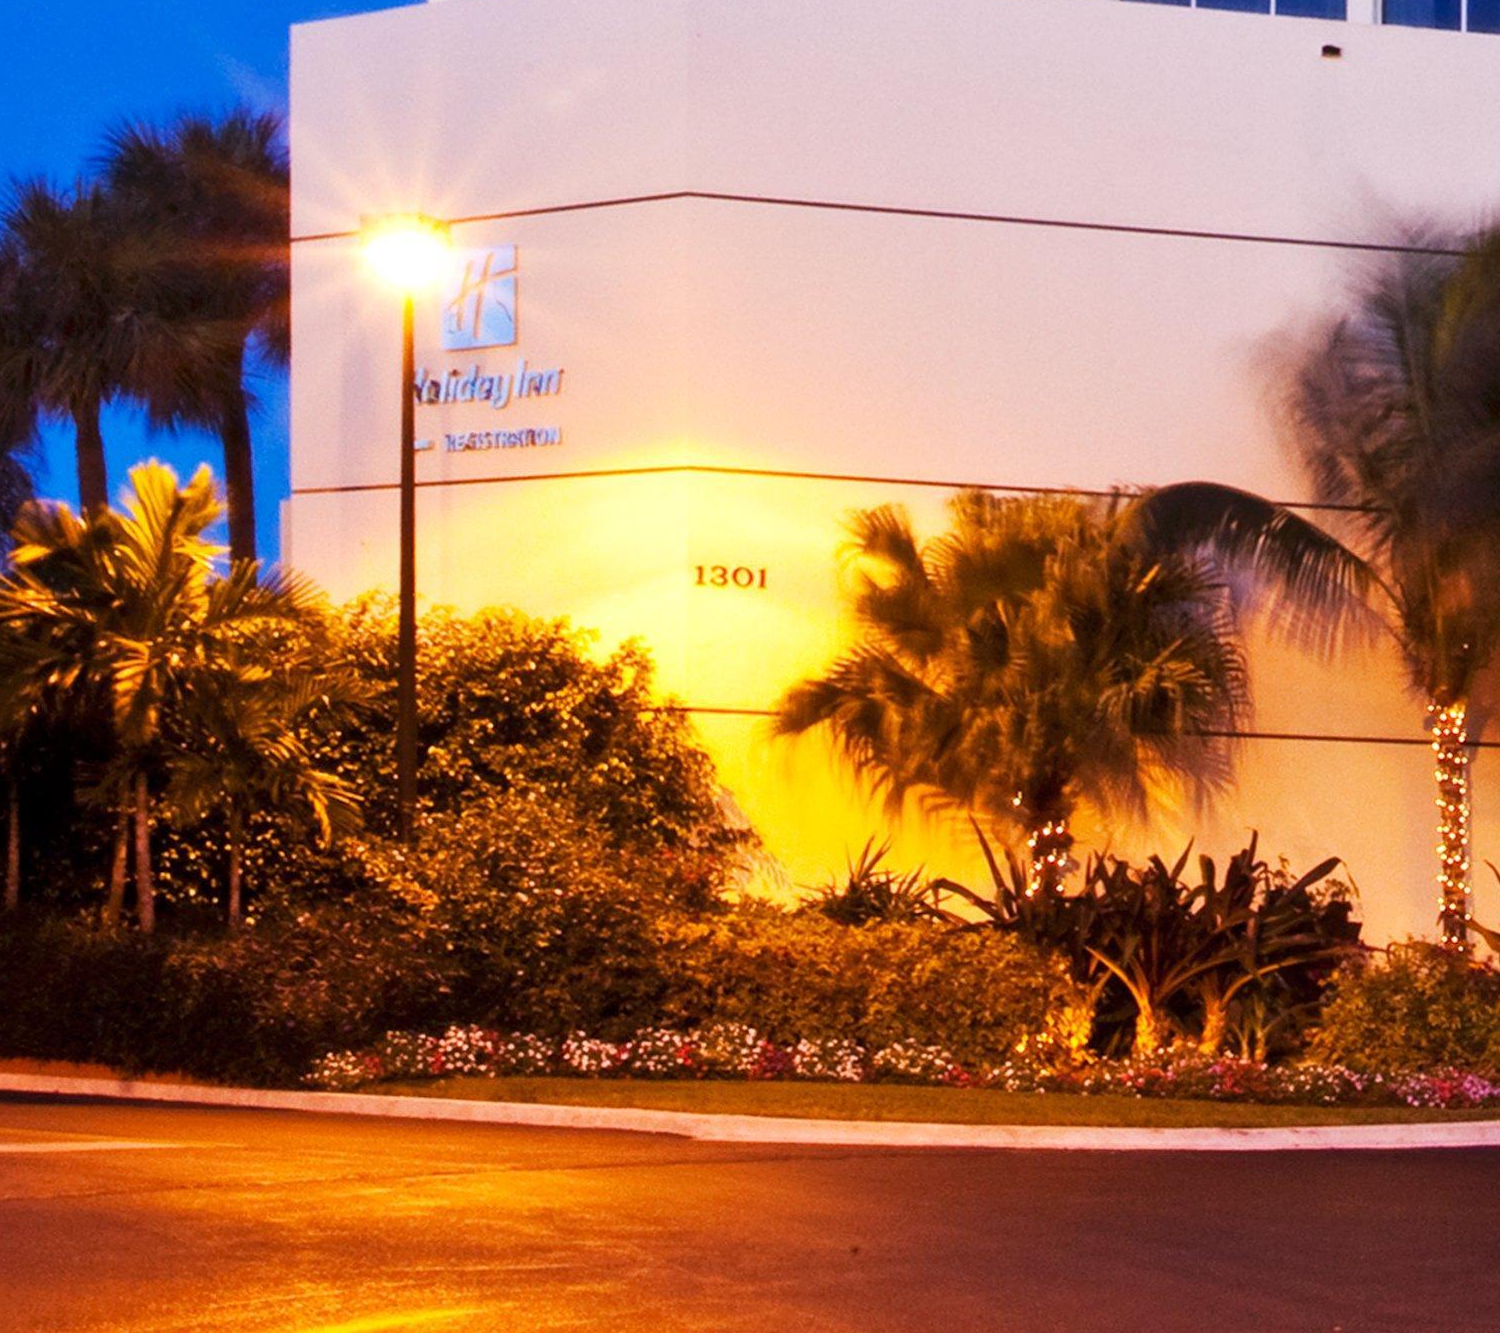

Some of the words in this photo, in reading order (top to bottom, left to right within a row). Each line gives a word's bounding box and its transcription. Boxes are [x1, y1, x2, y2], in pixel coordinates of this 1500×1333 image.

[514, 357, 561, 397] Inn
[446, 427, 561, 452] REGISTRATION
[695, 565, 767, 589] 1301
